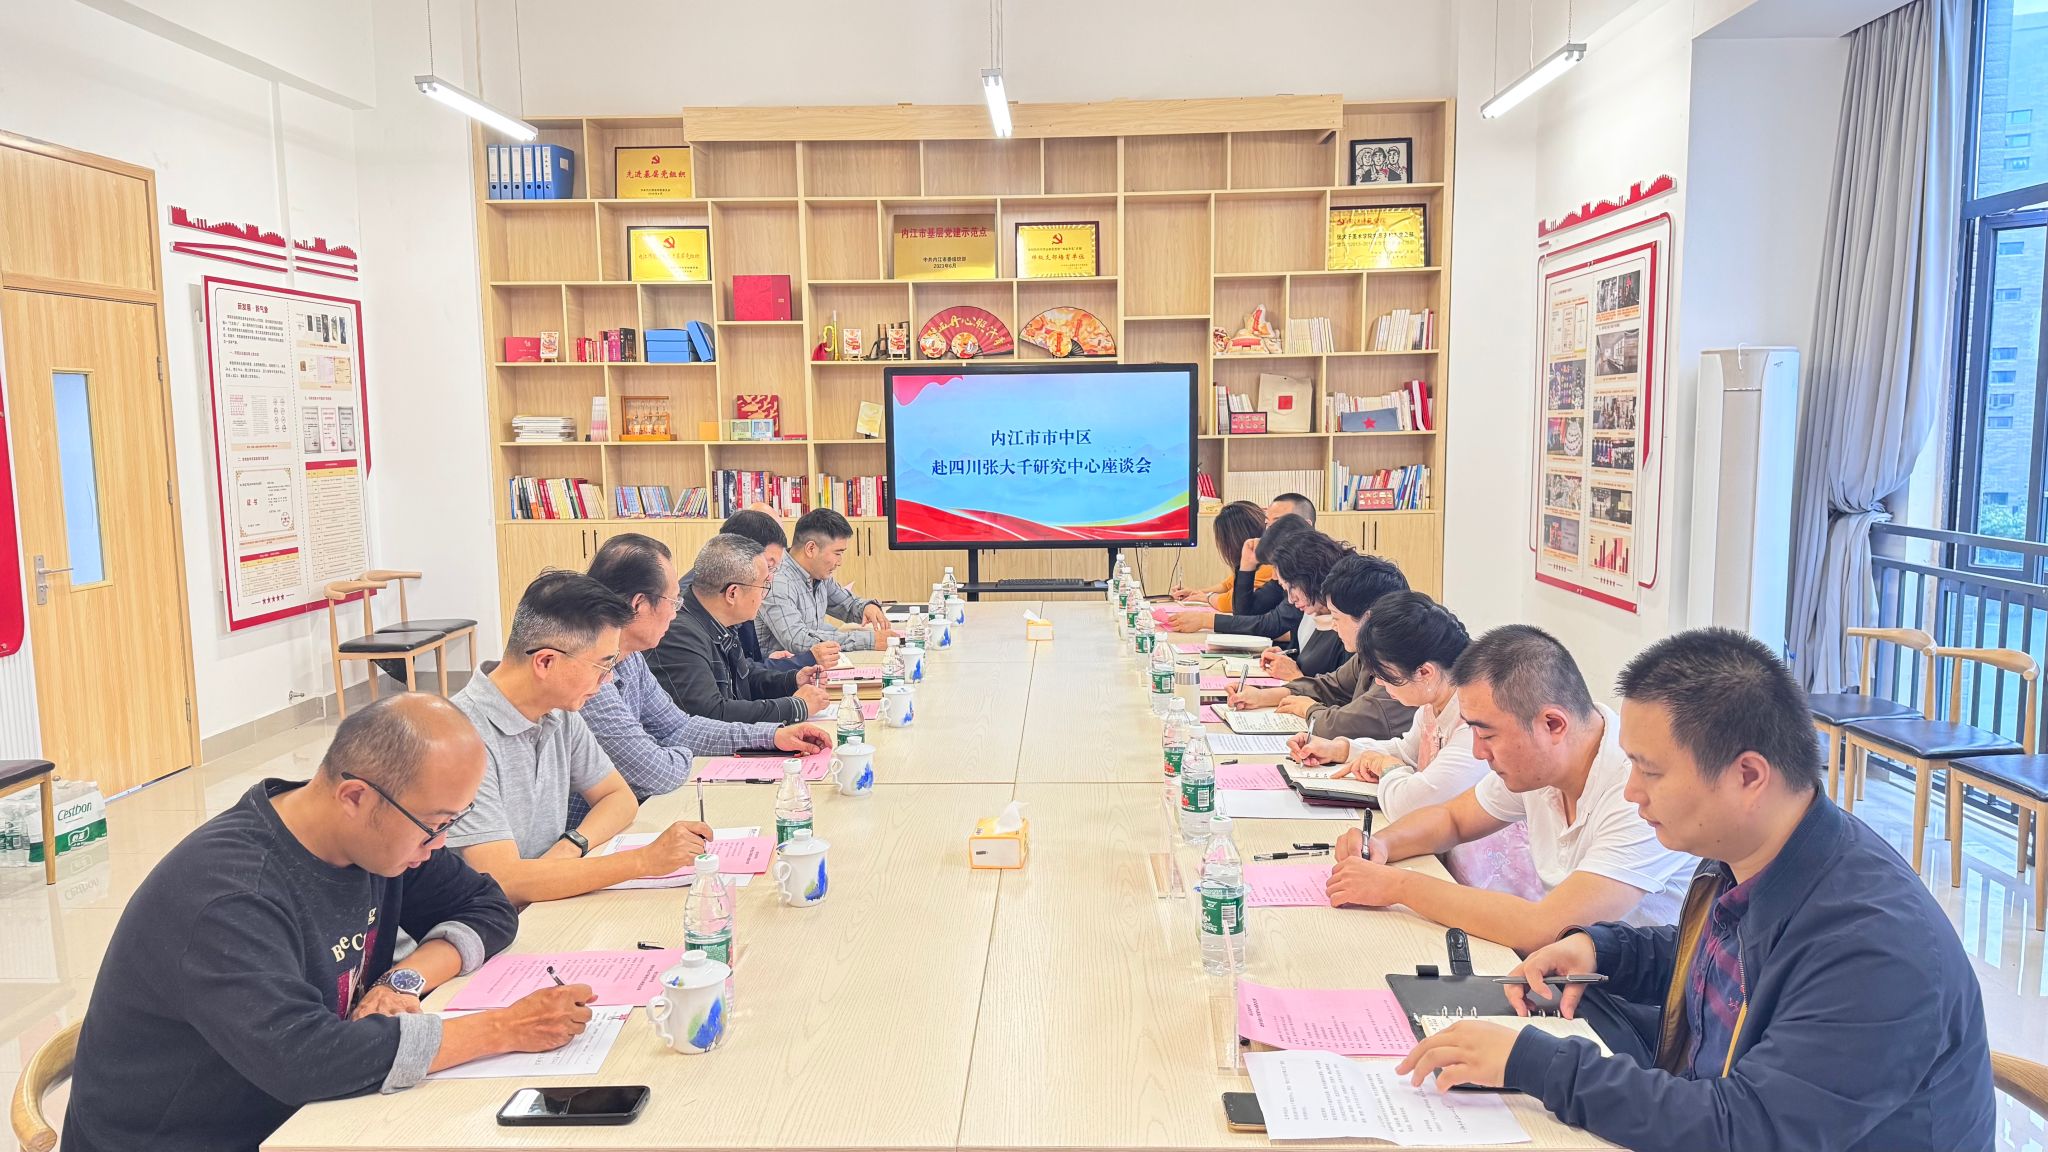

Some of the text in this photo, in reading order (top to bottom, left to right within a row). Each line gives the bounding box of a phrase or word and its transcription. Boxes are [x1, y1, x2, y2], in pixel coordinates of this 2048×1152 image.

[626, 169, 686, 179] 先进基层党组织
[901, 227, 987, 239] 内江市基层党建示范点
[991, 429, 1092, 446] 内江市市中区
[931, 457, 1151, 476] 赴四川张大千研究中心座谈会
[57, 802, 92, 821] Cestbon
